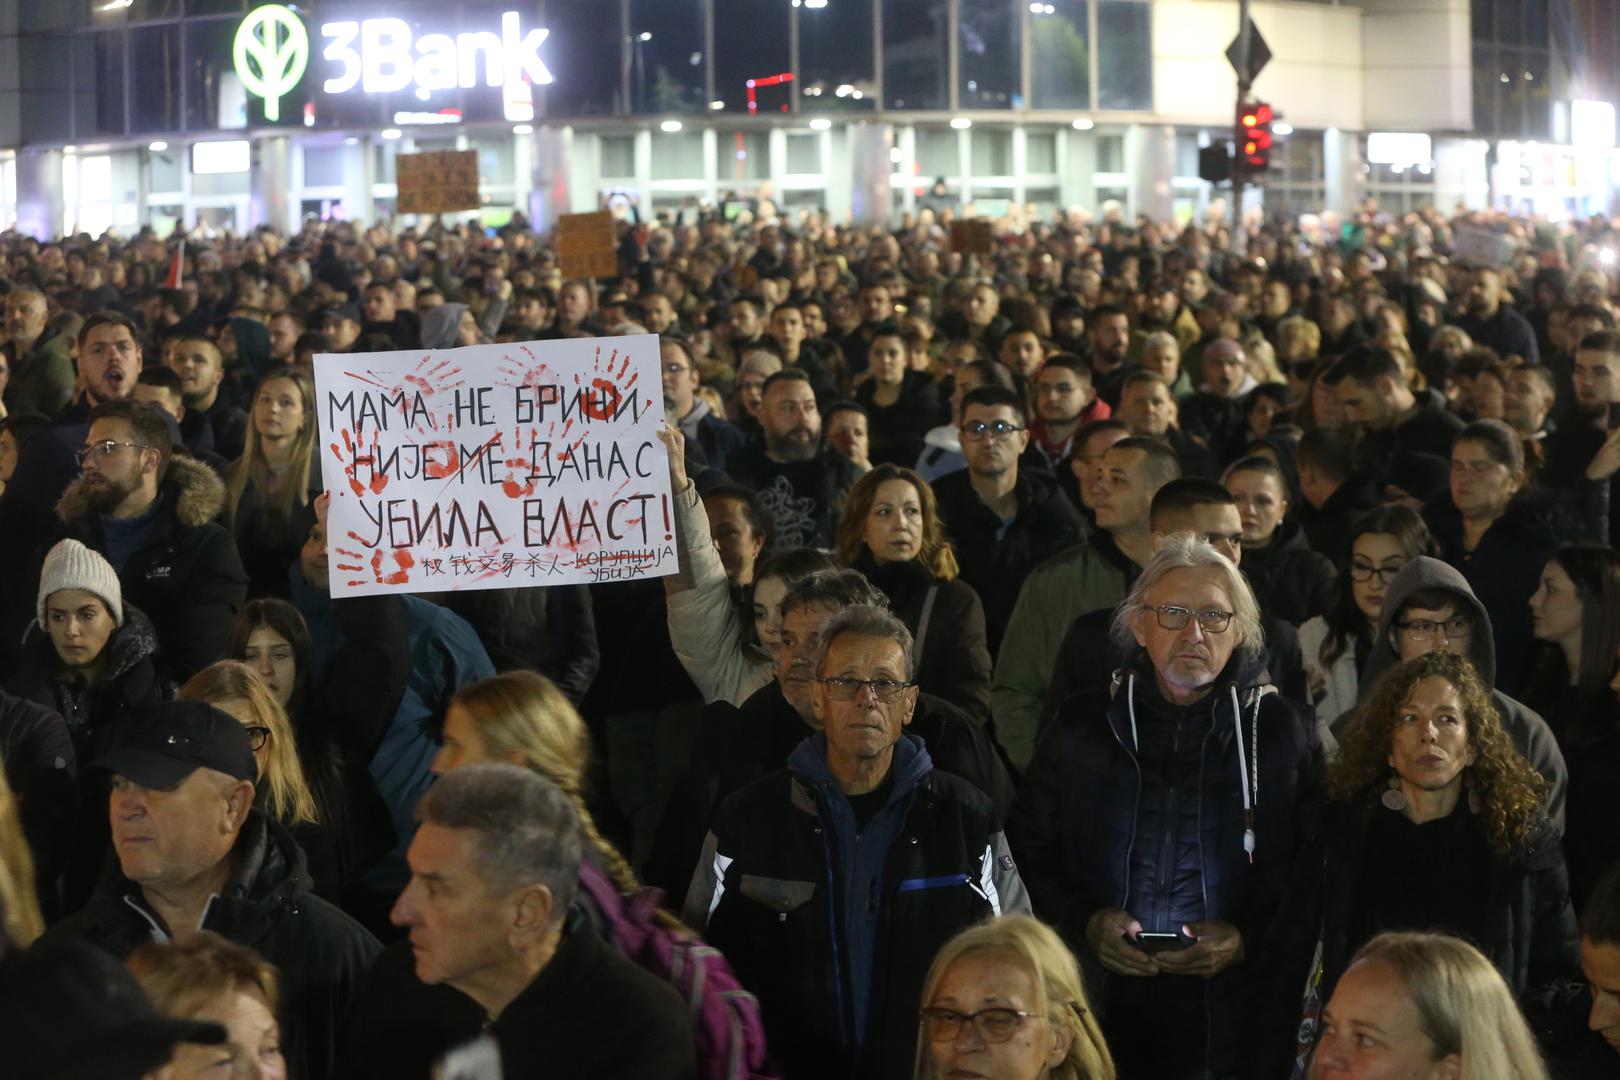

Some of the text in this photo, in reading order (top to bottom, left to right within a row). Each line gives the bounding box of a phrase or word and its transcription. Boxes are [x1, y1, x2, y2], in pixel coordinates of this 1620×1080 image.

[321, 11, 553, 94] 3Bank
[329, 390, 432, 433] МАМА
[454, 387, 496, 428] НЕ
[352, 441, 653, 487] НИЈЕ МЕ ДАНАС
[359, 493, 673, 548] УБИЛА ВЛАСТ!
[575, 544, 674, 567] КОРУПЦИЈА
[590, 565, 645, 582] УБИЈА
